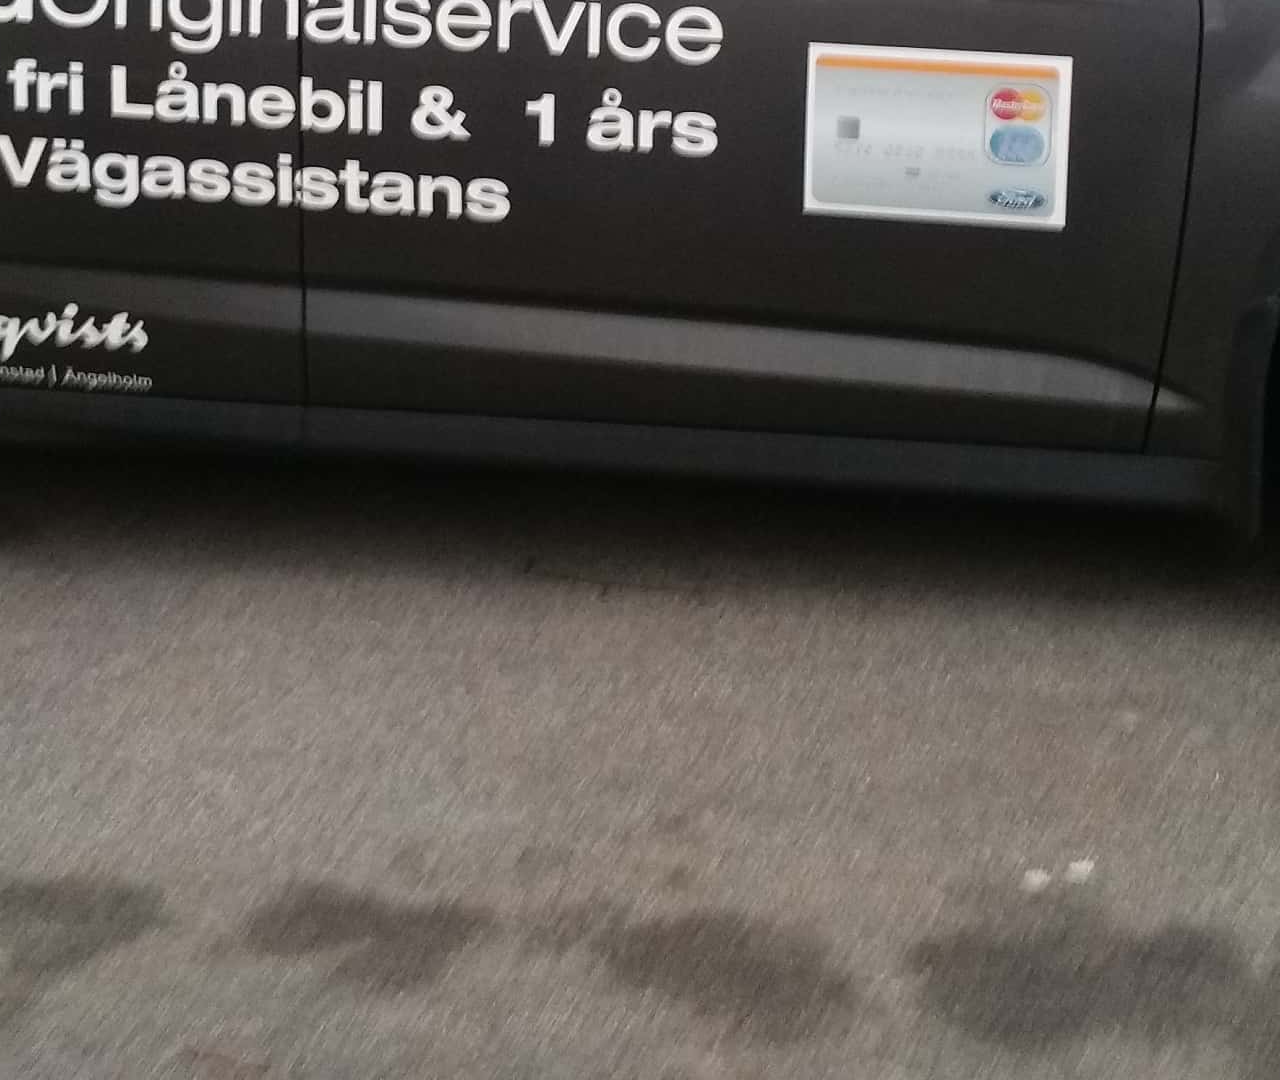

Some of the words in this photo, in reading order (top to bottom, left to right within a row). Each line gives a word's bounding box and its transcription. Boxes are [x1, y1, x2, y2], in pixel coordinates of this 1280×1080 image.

[7, 58, 84, 115] fri
[109, 61, 384, 136] Lånebil
[410, 85, 471, 141] &
[525, 93, 555, 147] 1
[586, 87, 719, 158] års
